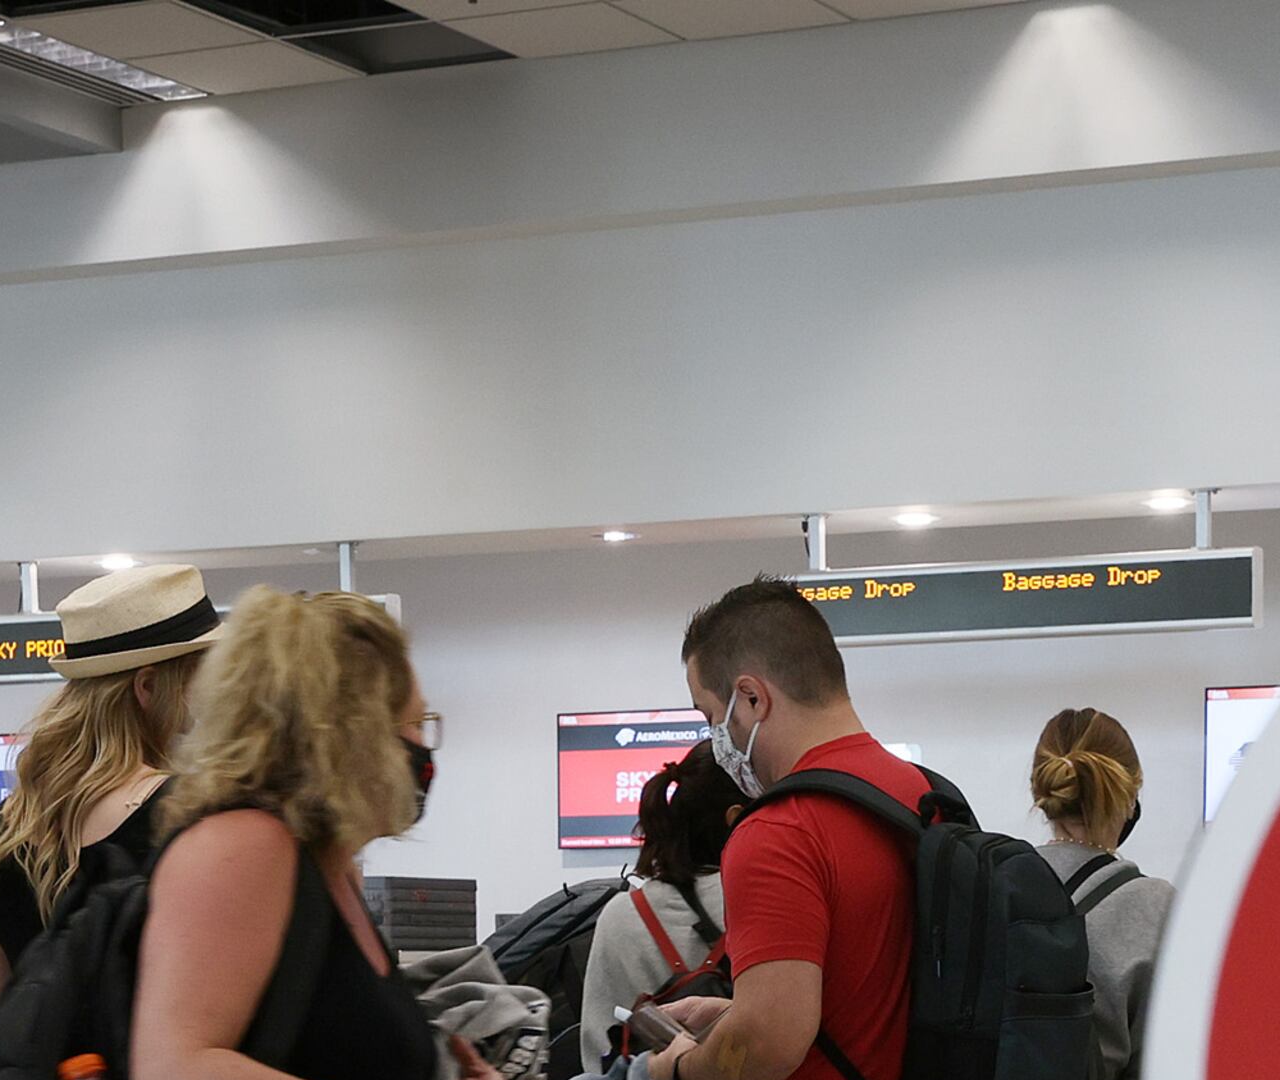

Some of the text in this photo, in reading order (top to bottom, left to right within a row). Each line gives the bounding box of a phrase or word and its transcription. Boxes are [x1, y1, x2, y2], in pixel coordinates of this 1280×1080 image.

[1001, 566, 1162, 592] Baggage Drop
[796, 579, 916, 602] gage Drop
[25, 639, 66, 659] PRIO
[615, 771, 657, 787] SKY
